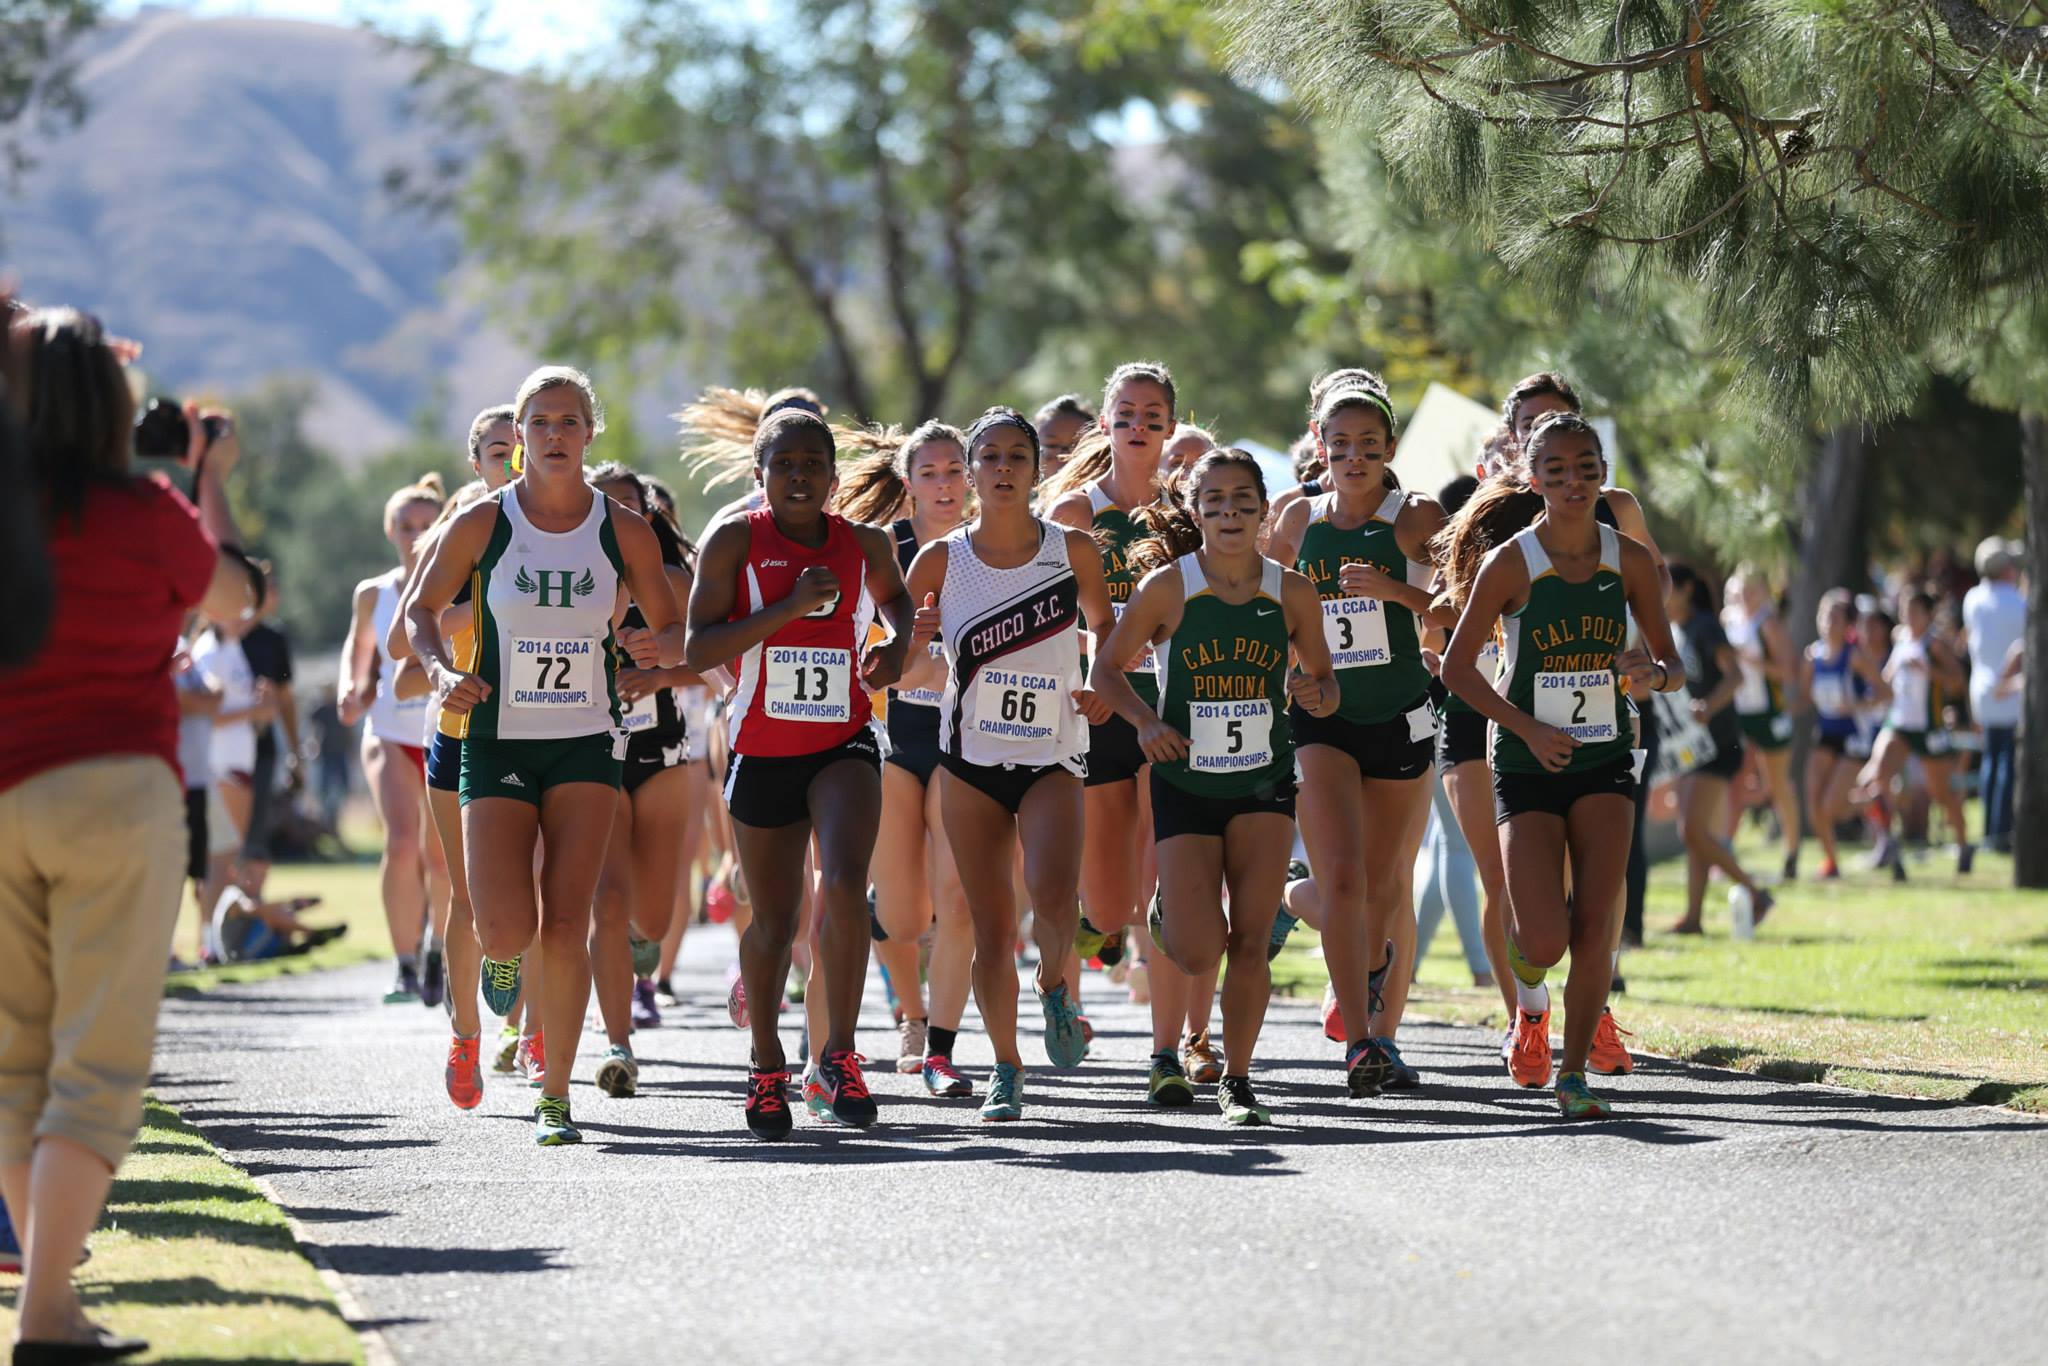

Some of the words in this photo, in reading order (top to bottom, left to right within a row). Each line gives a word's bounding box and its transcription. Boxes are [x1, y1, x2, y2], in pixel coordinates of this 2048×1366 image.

[534, 570, 577, 608] H
[1323, 603, 1339, 616] 14
[1342, 599, 1378, 614] CCAA
[971, 612, 1024, 657] CHICO
[1033, 594, 1064, 628] X.C.
[1336, 617, 1354, 650] 3
[1532, 618, 1576, 651] CAL
[1580, 615, 1625, 647] POLY
[518, 640, 551, 654] 2014
[555, 641, 590, 654] CCAA
[929, 644, 943, 656] 14
[1182, 638, 1226, 671] CAL
[1233, 636, 1282, 672] POLY
[1331, 648, 1384, 665] MPIONSHIPS
[773, 650, 807, 664] 2014
[812, 651, 846, 666] CCAA
[536, 657, 571, 690] 72
[985, 671, 1017, 686] 2014
[1021, 674, 1056, 690] CCAA
[1541, 675, 1576, 689] 2014
[1580, 673, 1610, 688] CCAA
[793, 667, 829, 702] 13
[1192, 675, 1266, 698] POMONA
[515, 690, 587, 704] CHAMPIONSHIPS
[1001, 689, 1036, 723] 66
[771, 701, 845, 718] CHAMPIONSHIPS
[1196, 705, 1229, 718] 2014
[1234, 703, 1268, 717] CCAA
[1571, 690, 1587, 724] 2
[979, 719, 1053, 738] CHAMPIONSHIPS
[1227, 720, 1243, 754] 5
[1196, 751, 1268, 769] CHAMPIONSHIPS
